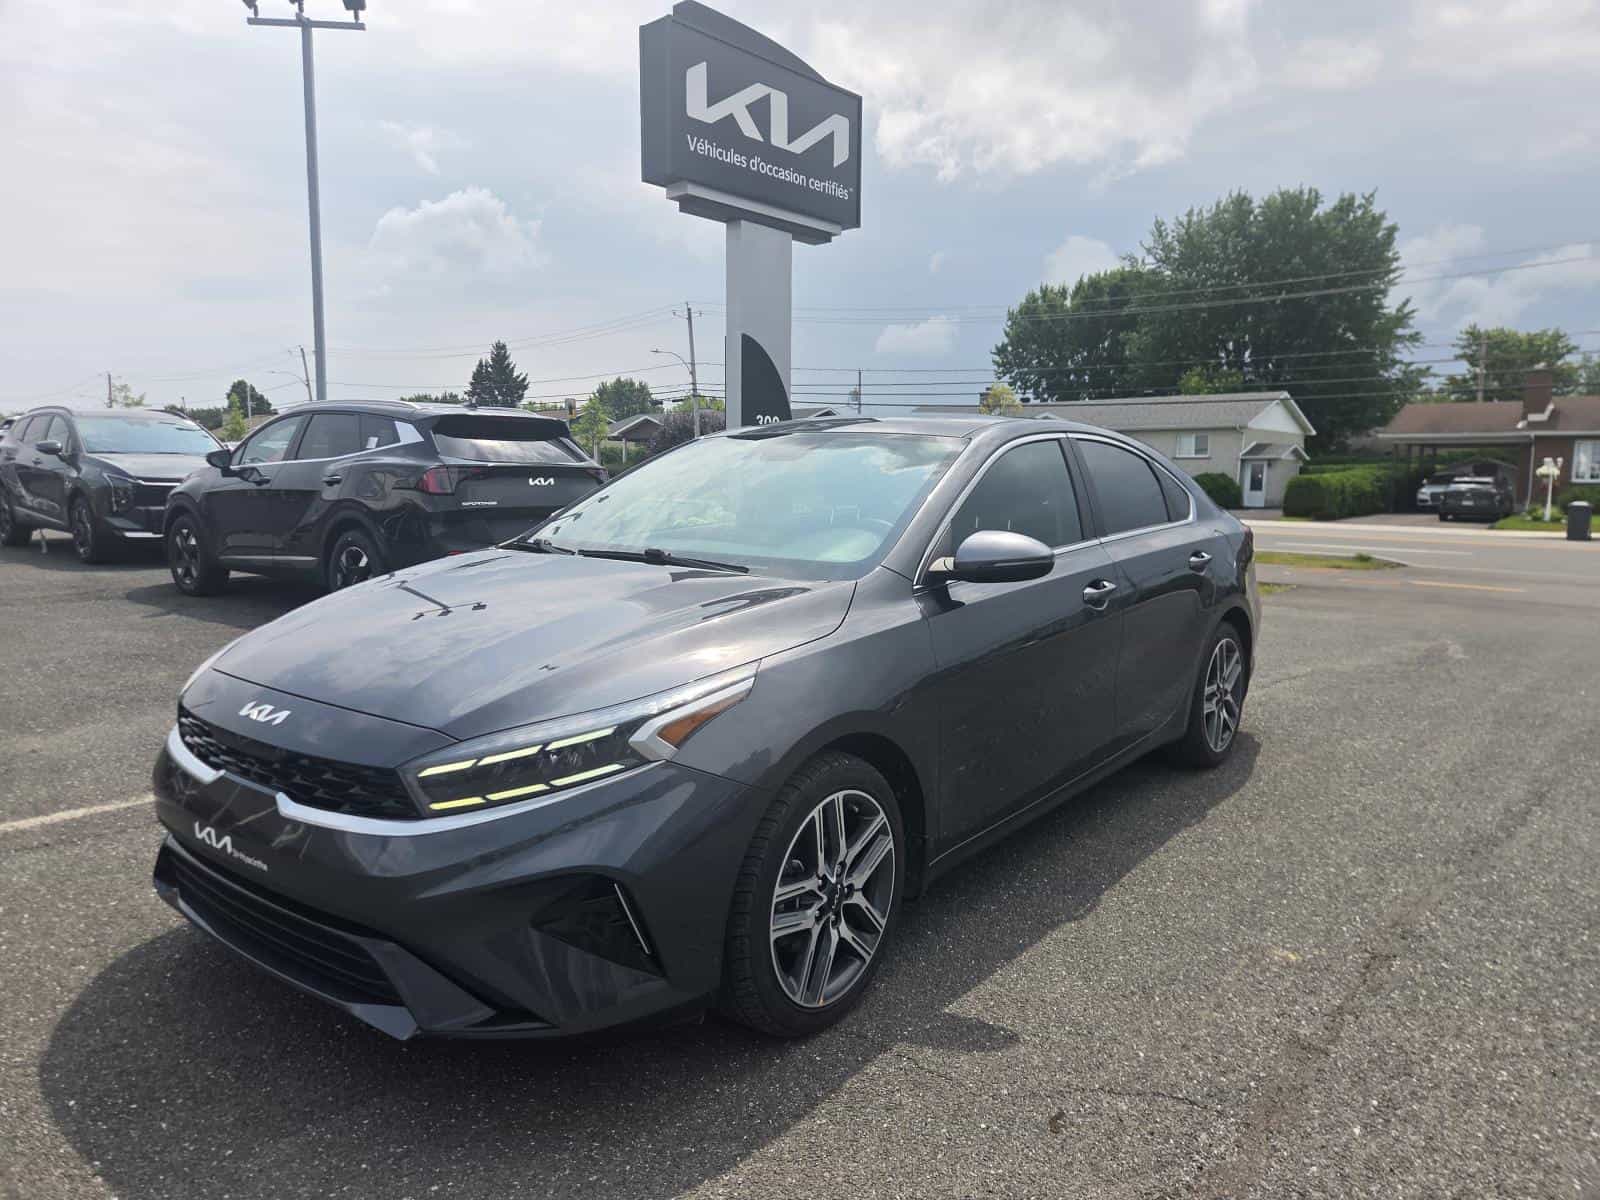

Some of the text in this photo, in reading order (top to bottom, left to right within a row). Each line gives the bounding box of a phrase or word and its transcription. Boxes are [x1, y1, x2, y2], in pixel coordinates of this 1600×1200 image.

[686, 61, 850, 168] KIA
[686, 134, 849, 200] Véhicules d'occasion certifiés
[528, 477, 555, 486] KIA
[238, 701, 291, 725] KIA
[194, 821, 233, 854] KIA
